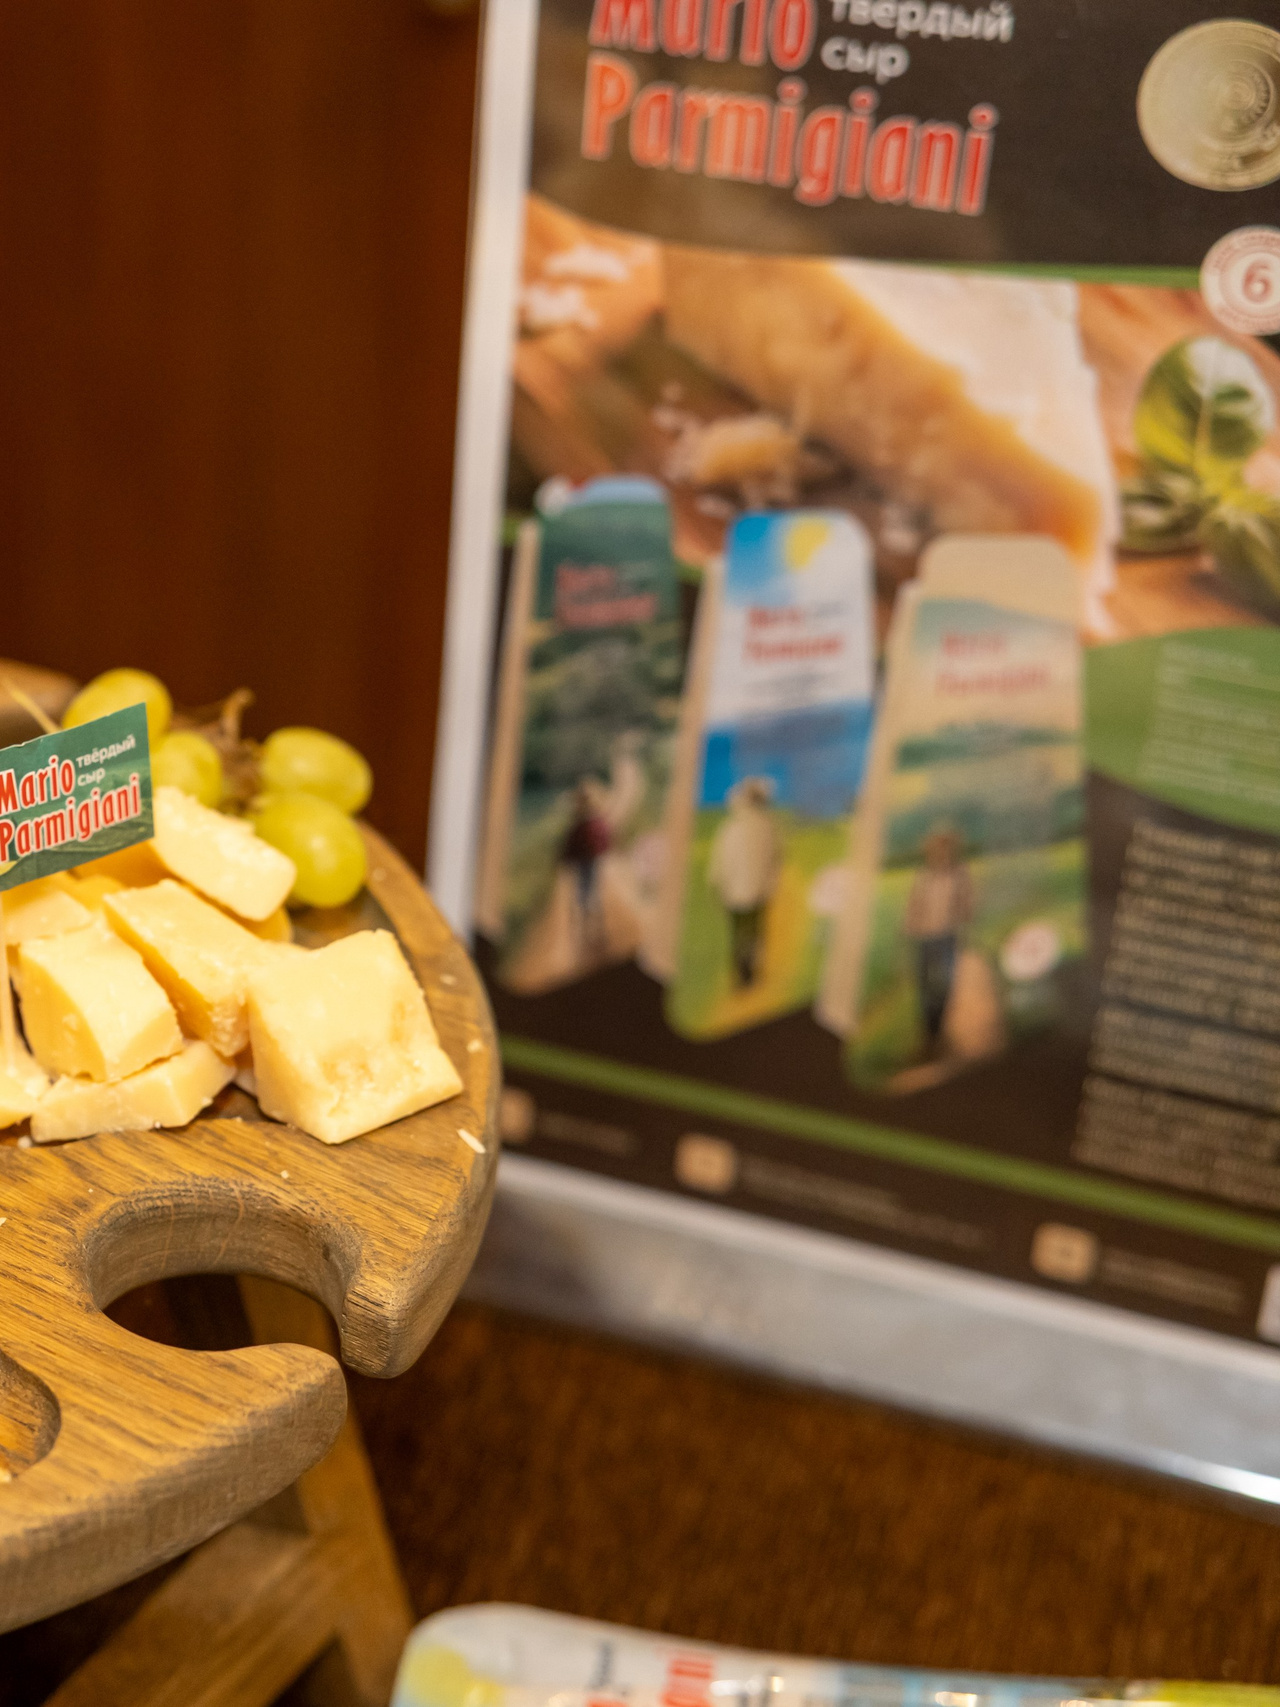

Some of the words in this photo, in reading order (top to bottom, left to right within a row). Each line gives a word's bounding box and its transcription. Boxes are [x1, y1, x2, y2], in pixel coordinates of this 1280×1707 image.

[821, 36, 910, 85] сыр
[581, 50, 1000, 216] Parmigiani
[1243, 261, 1272, 305] 6
[76, 734, 136, 768] твёрдый
[77, 767, 106, 787] сыр
